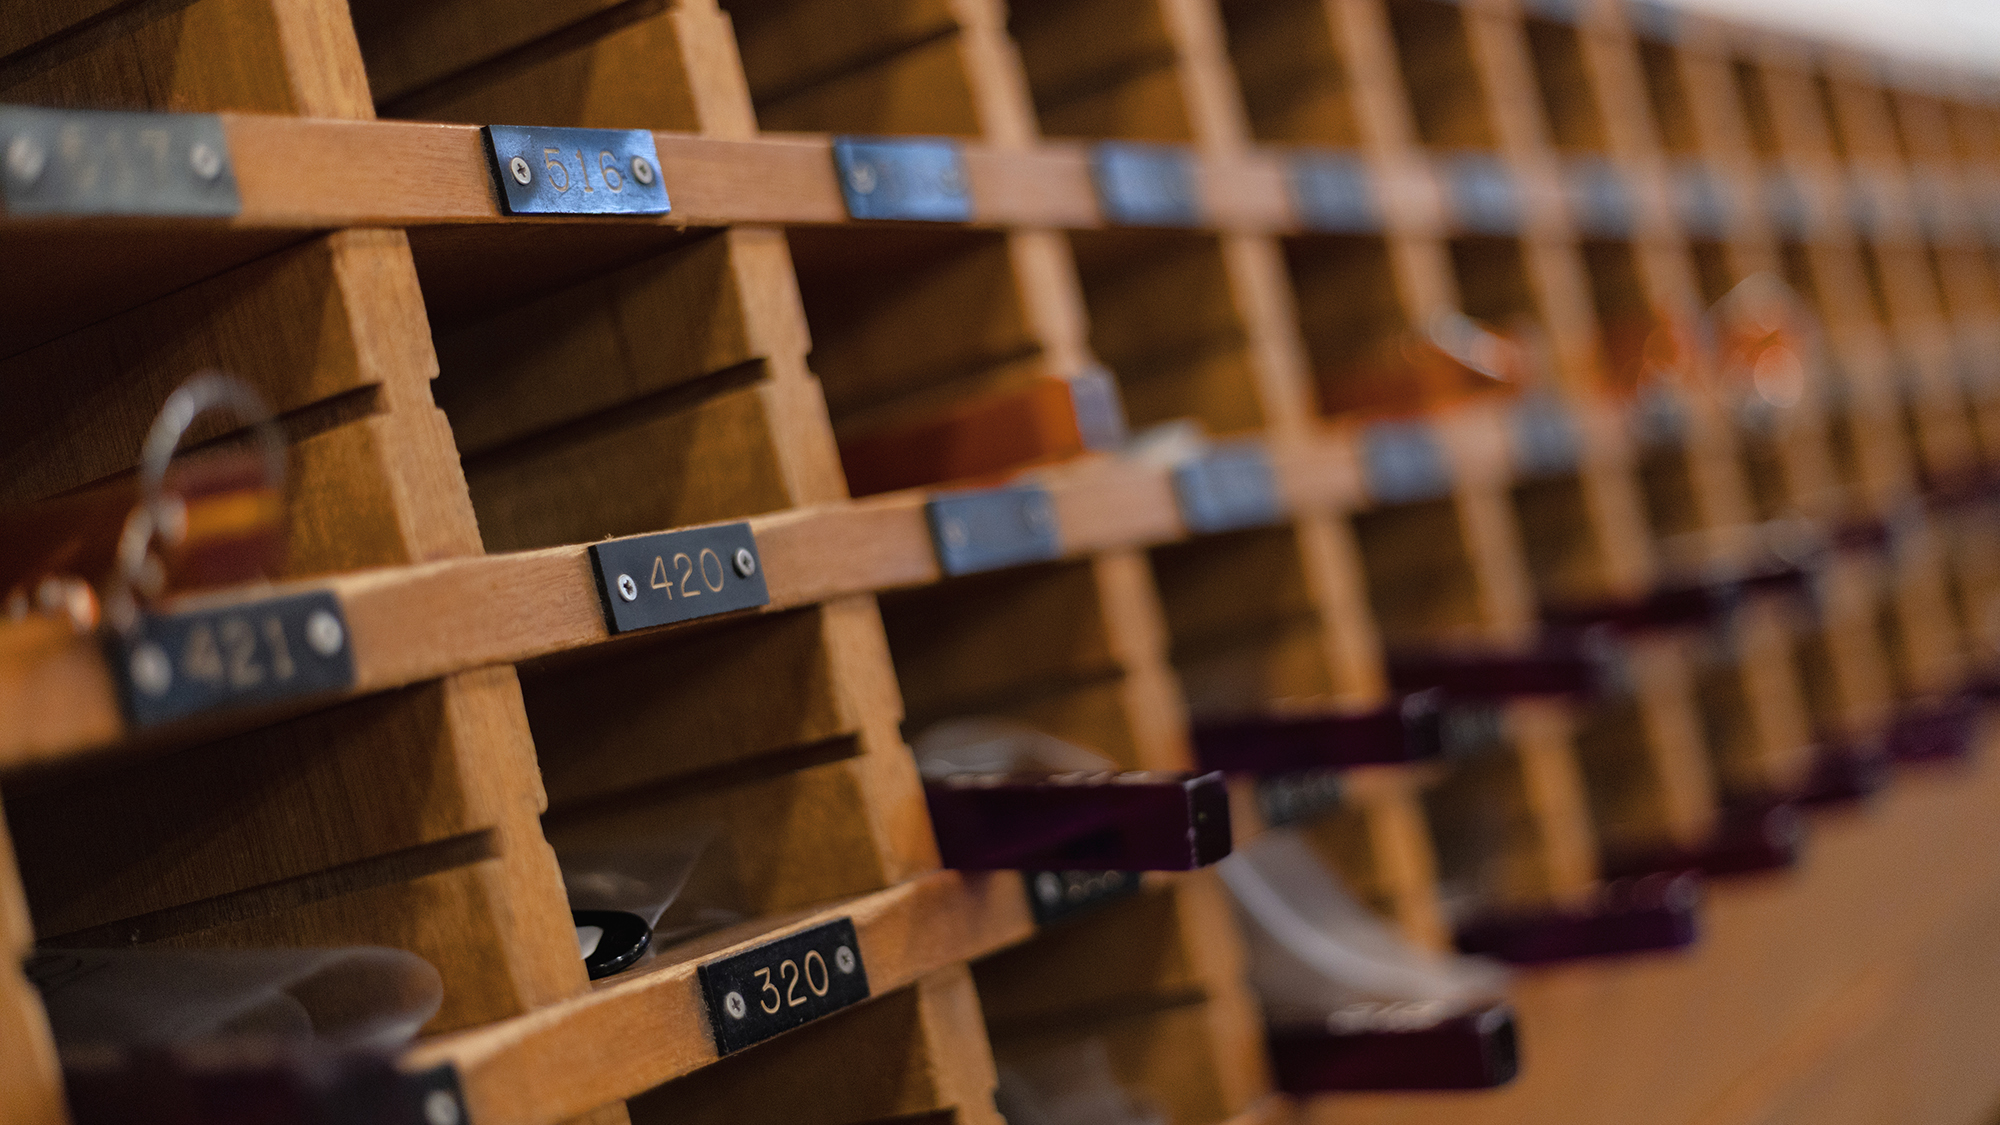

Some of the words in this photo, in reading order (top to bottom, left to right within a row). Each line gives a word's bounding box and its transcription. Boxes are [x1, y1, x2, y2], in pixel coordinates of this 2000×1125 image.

[543, 147, 623, 194] 516
[650, 547, 724, 601] 420
[183, 617, 296, 688] 421
[754, 949, 830, 1014] 320
